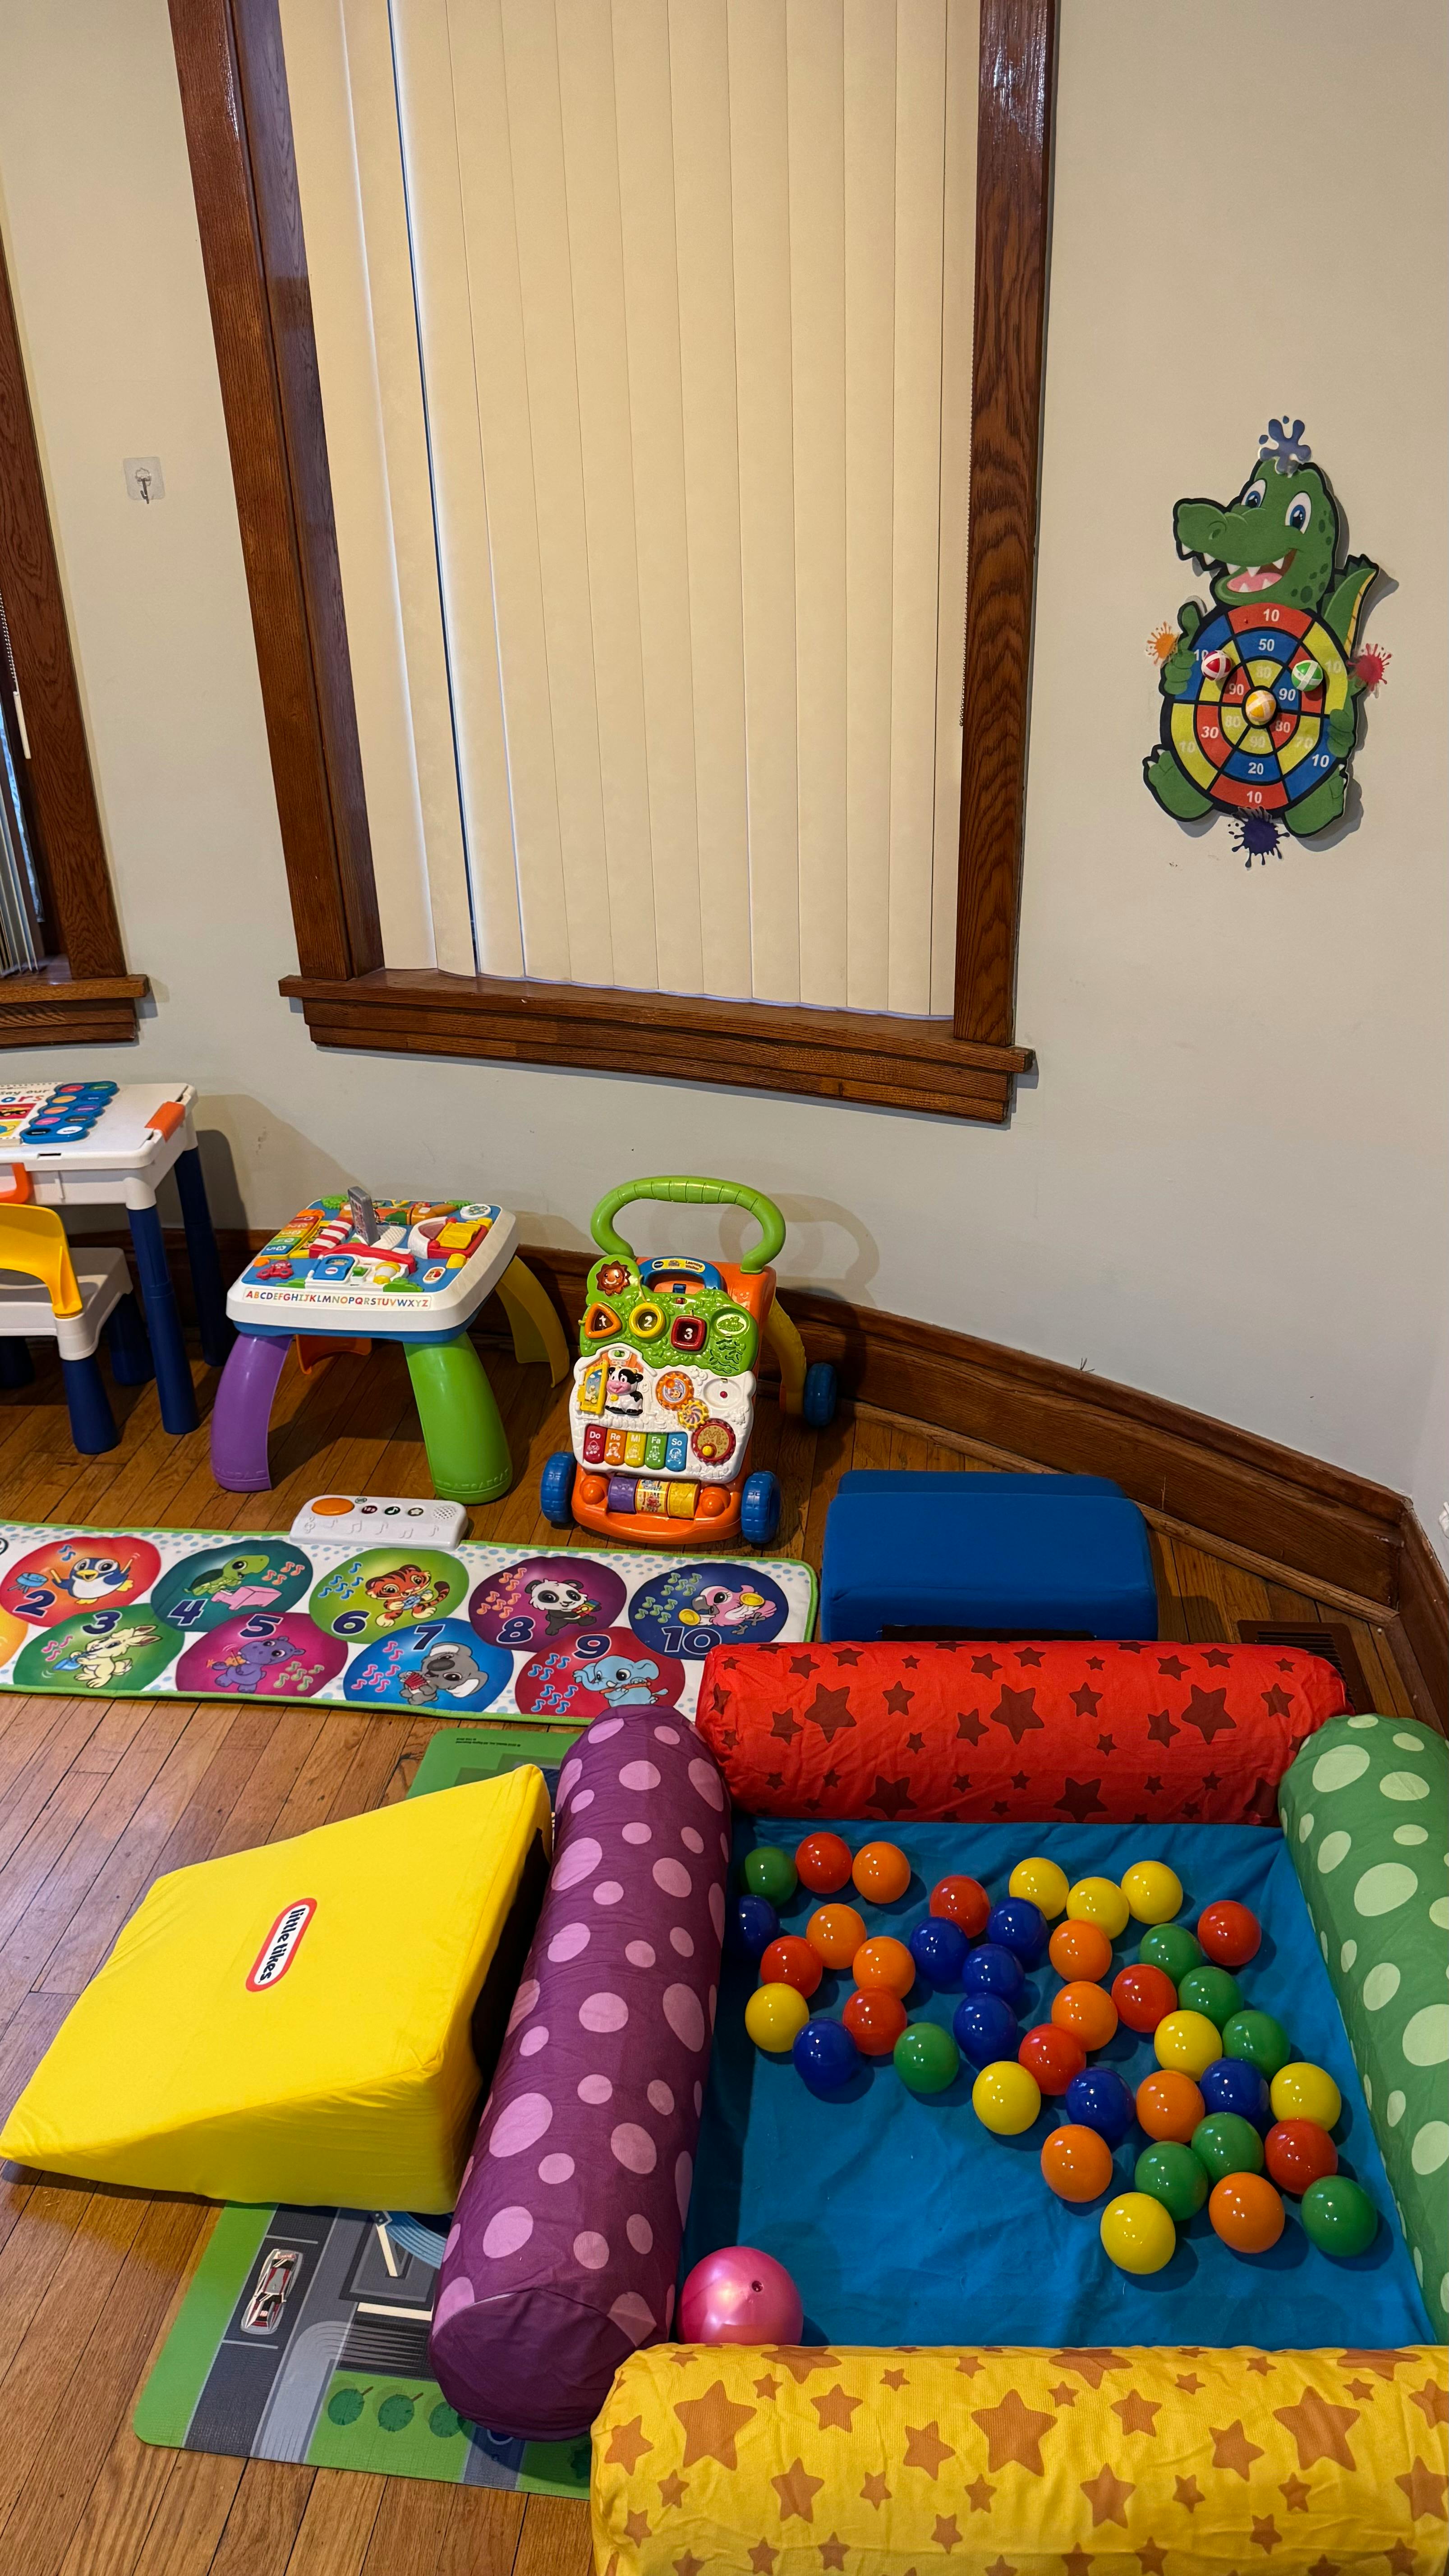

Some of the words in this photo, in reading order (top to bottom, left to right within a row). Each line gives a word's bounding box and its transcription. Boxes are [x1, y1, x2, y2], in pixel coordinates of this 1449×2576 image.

[1263, 609, 1279, 622] 10
[1258, 639, 1275, 652] 50
[1325, 661, 1342, 673] 10
[1228, 684, 1244, 695] 90
[1279, 688, 1296, 701] 90
[1201, 727, 1219, 738] 30
[1275, 722, 1290, 733] 80
[1312, 754, 1329, 768] 10
[1248, 762, 1264, 775] 20
[1247, 791, 1262, 804] 10
[246, 1290, 428, 1307] ABCDEFGHIJKLMNOPQRSTUVWXYZ
[644, 1315, 653, 1327] 2
[684, 1328, 693, 1340] 3
[589, 1431, 601, 1439] Do
[610, 1433, 621, 1441] Re
[13, 1589, 56, 1617] 2
[167, 1599, 208, 1626] 4
[81, 1610, 122, 1635] 3
[236, 1615, 283, 1638] 5
[331, 1610, 371, 1635] 6
[411, 1624, 446, 1651] 7
[496, 1616, 535, 1645] 8
[572, 1634, 612, 1659] 9
[661, 1625, 722, 1655] 10
[277, 1908, 306, 1943] little
[260, 1943, 288, 1981] tikes
